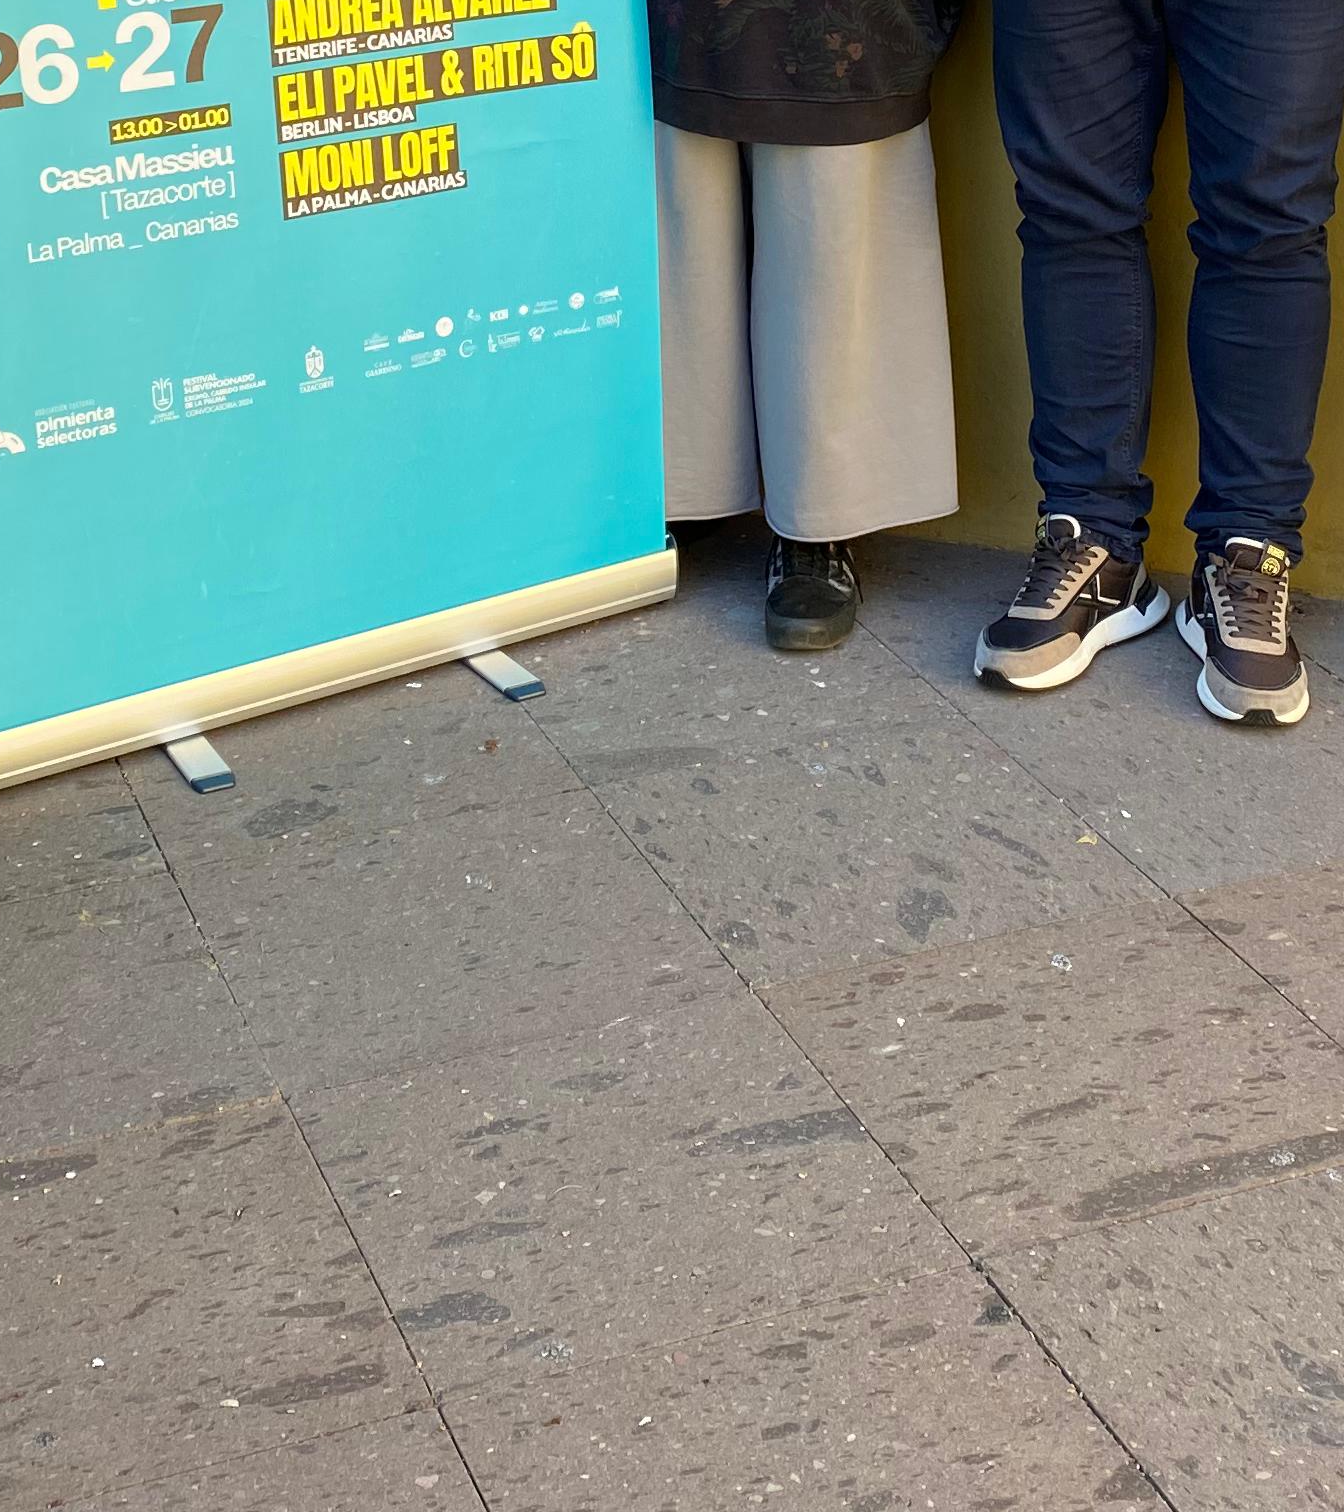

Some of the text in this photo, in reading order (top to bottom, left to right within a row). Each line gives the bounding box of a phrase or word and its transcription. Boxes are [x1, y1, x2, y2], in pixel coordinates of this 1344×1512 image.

[115, 4, 224, 93] 27
[277, 21, 595, 122] ELI PAVEL & RITA SÔ
[281, 117, 343, 142] BERLIN
[354, 106, 415, 129] LISBOA
[39, 143, 235, 194] Casa Massieu
[283, 125, 456, 198] MONI LOFF
[287, 200, 310, 219] LA
[312, 189, 373, 214] PALMA
[381, 170, 467, 201] CANARIAS
[27, 243, 55, 264] La
[57, 231, 125, 258] Palma
[146, 211, 239, 242] Canarias
[183, 373, 217, 386] FESTIVAL
[36, 405, 115, 438] pimienta
[37, 422, 117, 448] selectoras
